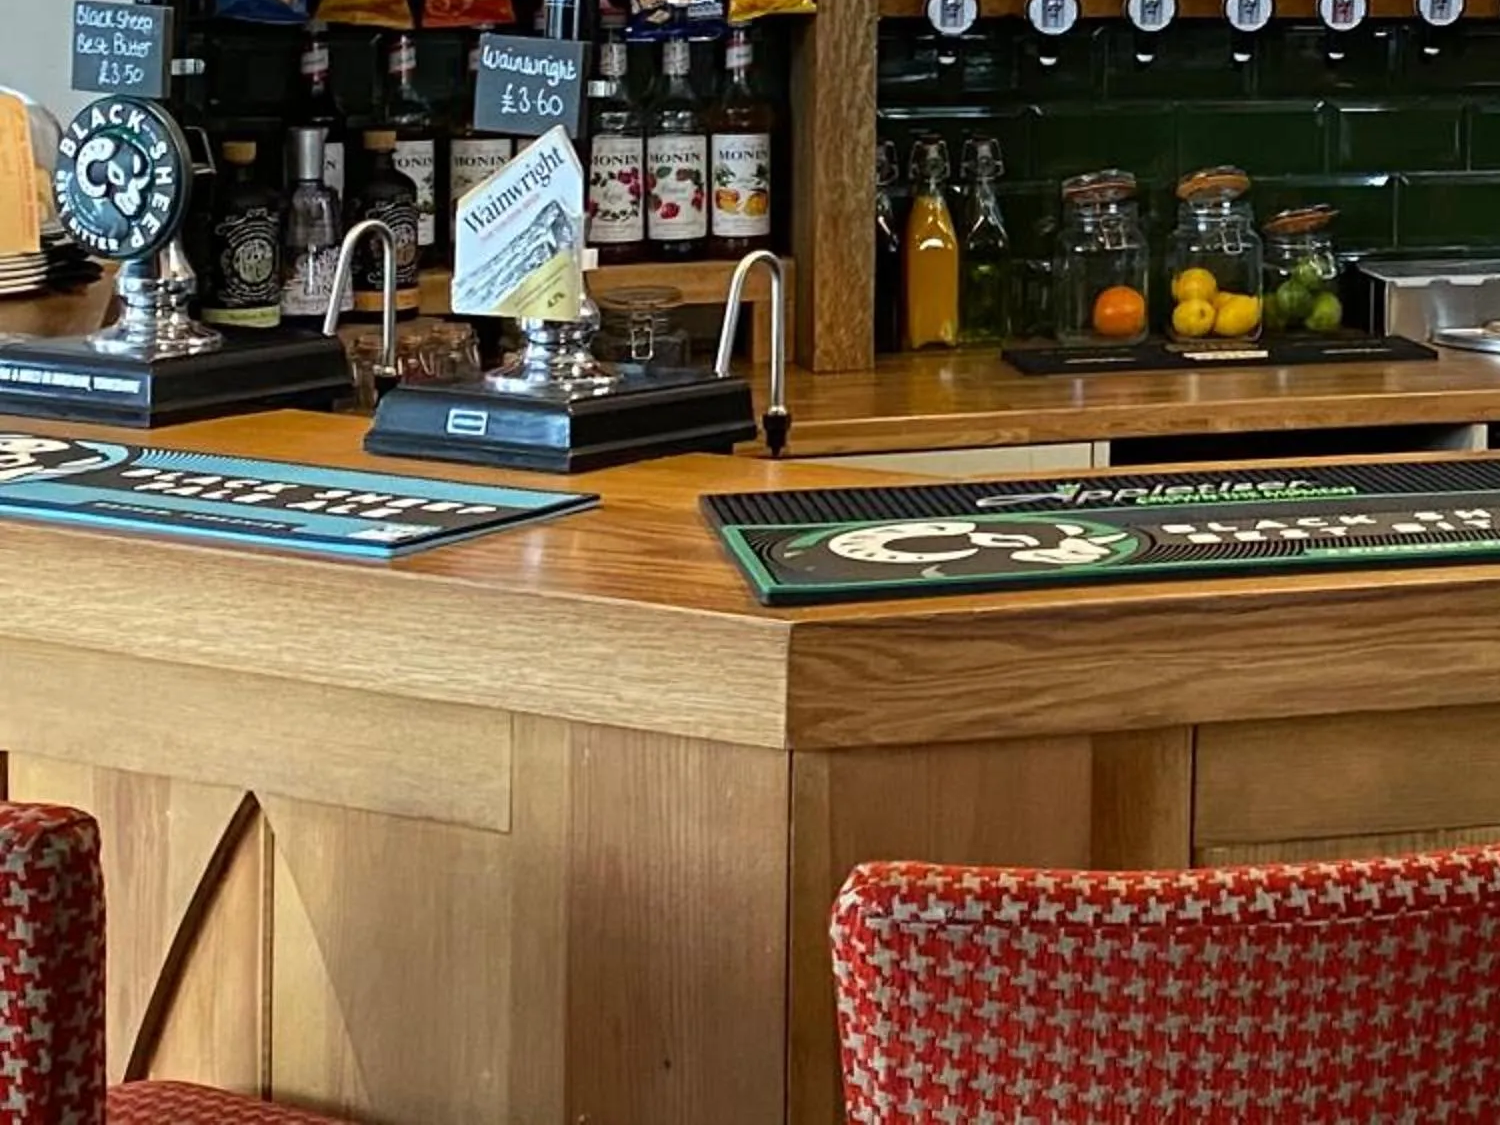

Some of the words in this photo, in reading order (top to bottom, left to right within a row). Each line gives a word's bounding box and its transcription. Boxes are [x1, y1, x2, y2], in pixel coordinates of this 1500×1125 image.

[75, 4, 116, 27] Black
[76, 34, 108, 57] Best
[482, 45, 577, 87] Wainwright
[649, 152, 701, 164] MONIN
[718, 148, 769, 161] MONIN
[59, 104, 146, 158] BLACK
[131, 140, 173, 248] SHEEP
[463, 143, 567, 236] Wainwright
[69, 217, 119, 251] BITTER
[1161, 514, 1378, 535] BLACK
